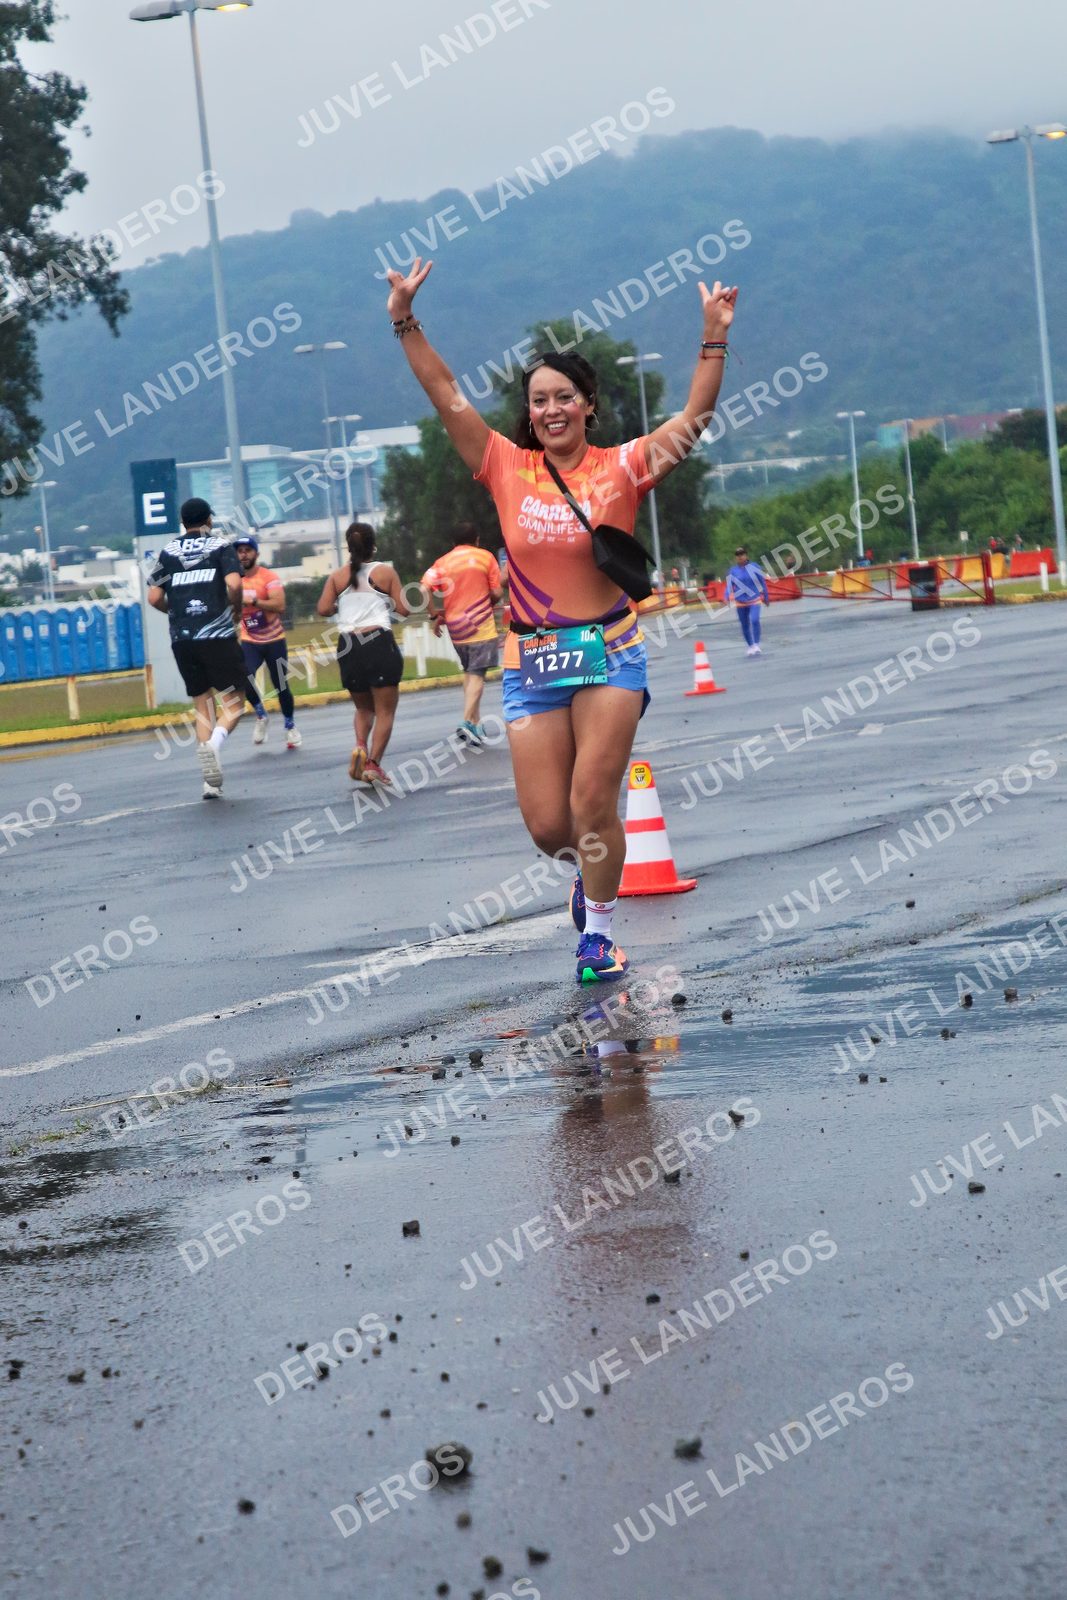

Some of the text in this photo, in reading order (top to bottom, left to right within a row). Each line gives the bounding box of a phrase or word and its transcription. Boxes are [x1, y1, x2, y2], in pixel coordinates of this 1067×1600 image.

[142, 491, 168, 526] E
[517, 513, 575, 535] OMNILIFE
[580, 629, 597, 643] 10K
[535, 650, 584, 674] 1277
